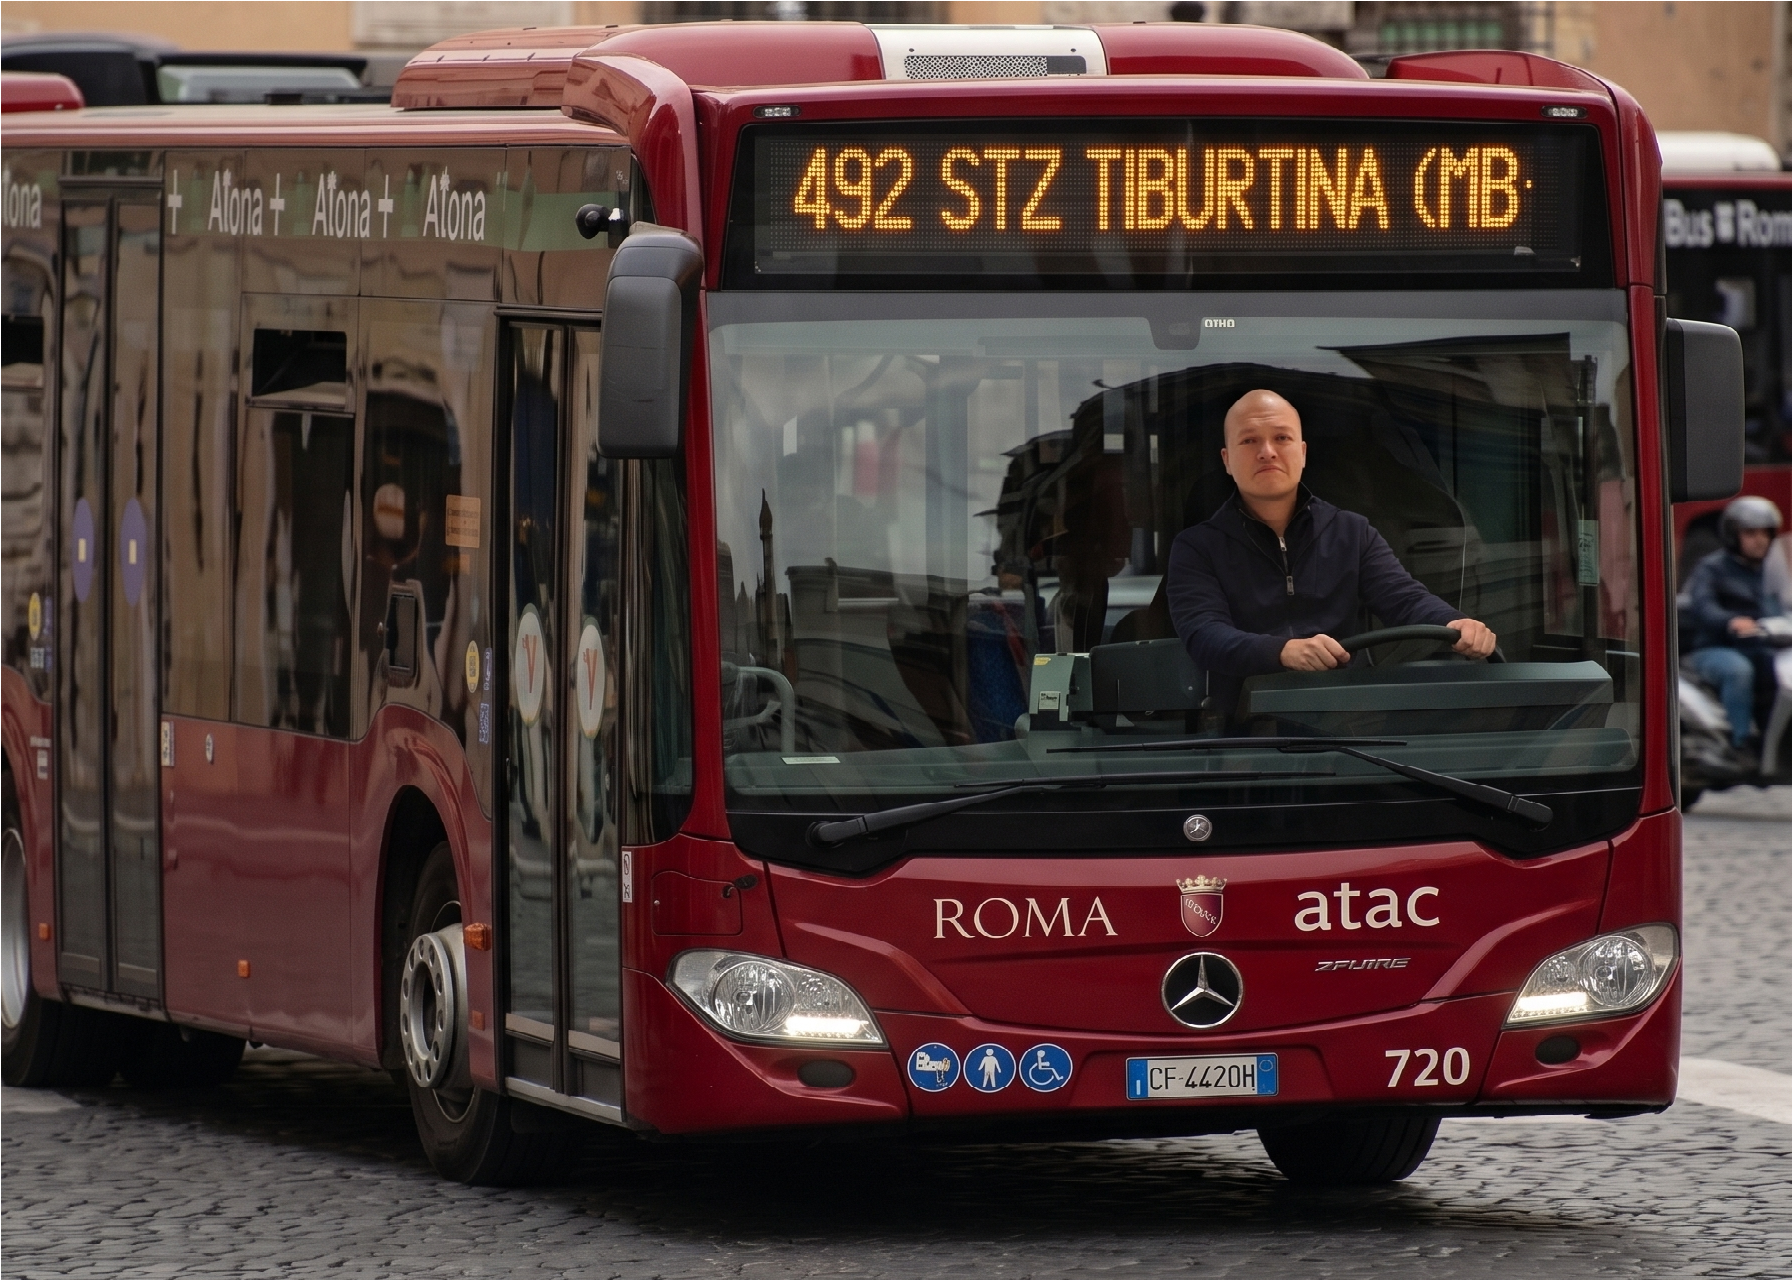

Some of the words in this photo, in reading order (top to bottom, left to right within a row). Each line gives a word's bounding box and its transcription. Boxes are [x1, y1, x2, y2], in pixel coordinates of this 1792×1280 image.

[794, 148, 912, 230] 492
[941, 148, 1061, 230] STZ
[1086, 148, 1389, 230] TIBURTINA
[1662, 198, 1714, 248] Bus
[933, 896, 1119, 939] ROMA
[1294, 882, 1440, 932] atac
[1385, 1047, 1470, 1088] 720
